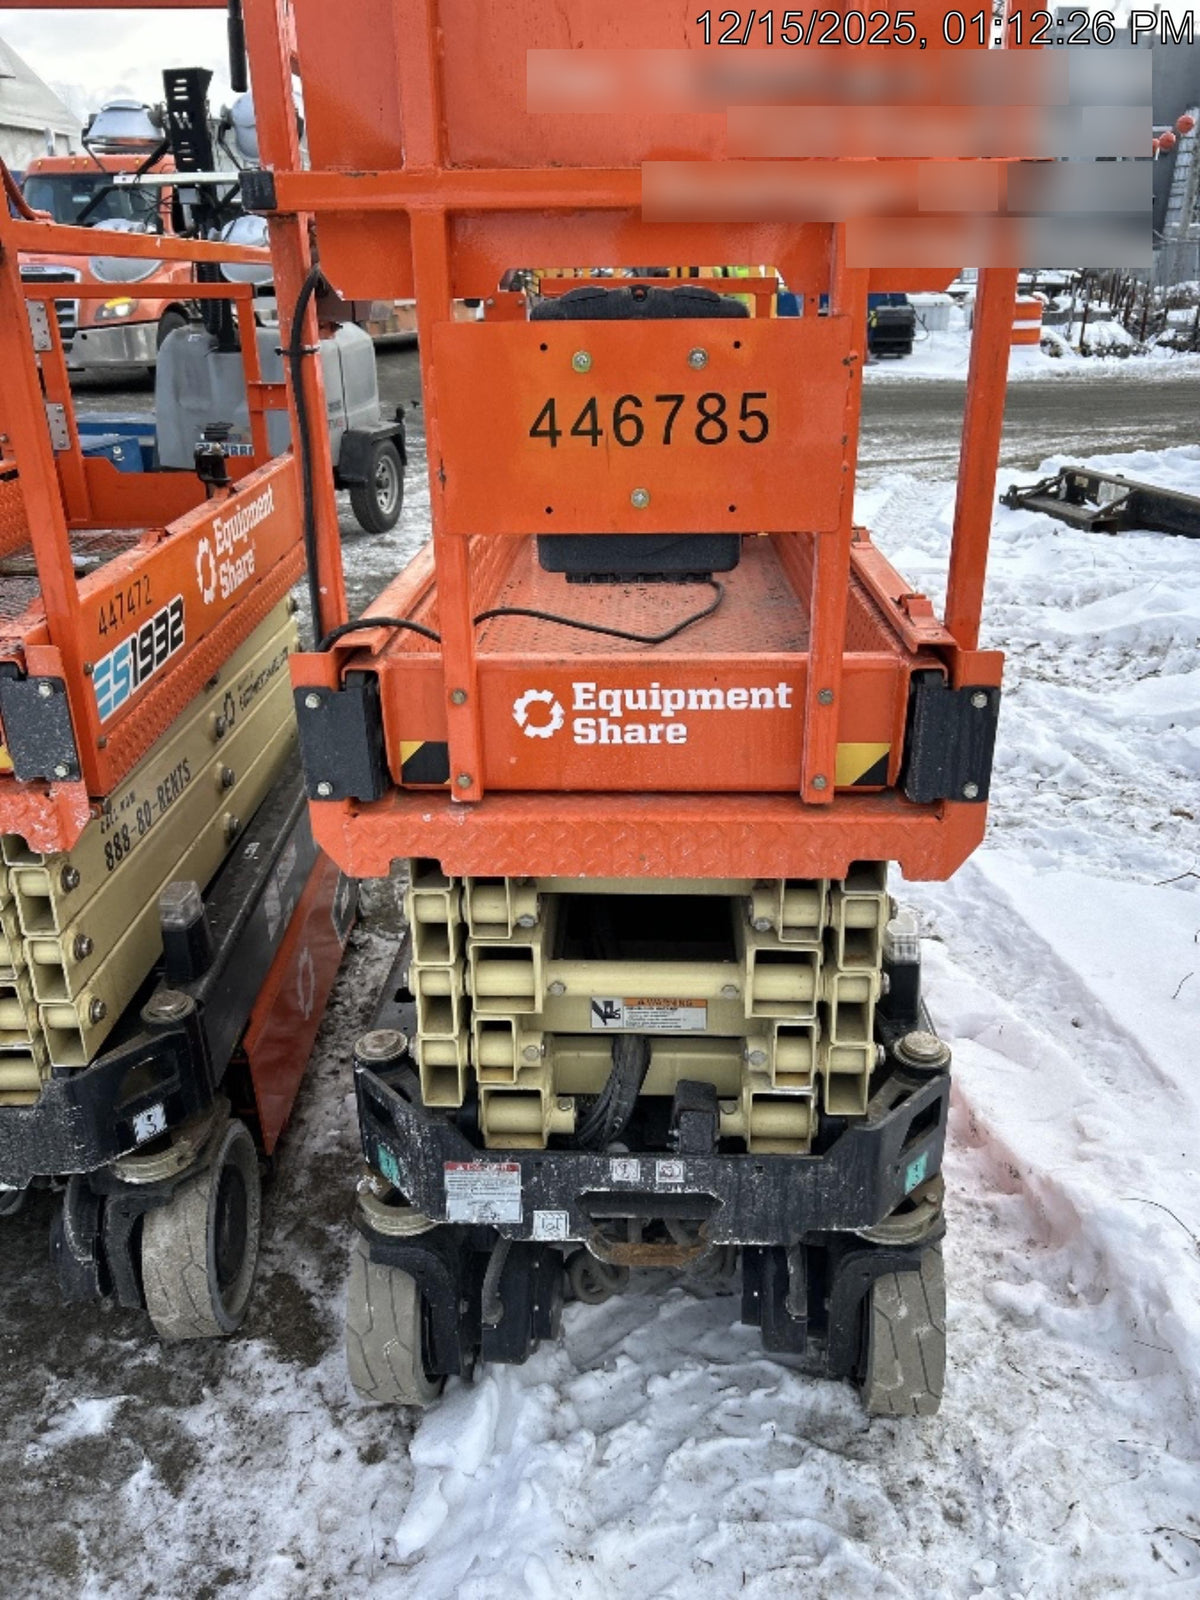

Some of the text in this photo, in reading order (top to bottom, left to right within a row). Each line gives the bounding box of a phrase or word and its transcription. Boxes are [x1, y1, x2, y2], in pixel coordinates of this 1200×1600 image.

[529, 392, 769, 448] 446785
[213, 485, 274, 556] Equipment
[219, 549, 255, 599] Share
[98, 574, 152, 636] 447472
[93, 593, 185, 724] ES1932
[572, 682, 793, 717] Equipment
[572, 717, 688, 745] Share
[104, 756, 191, 871] 888-80-RENTS
